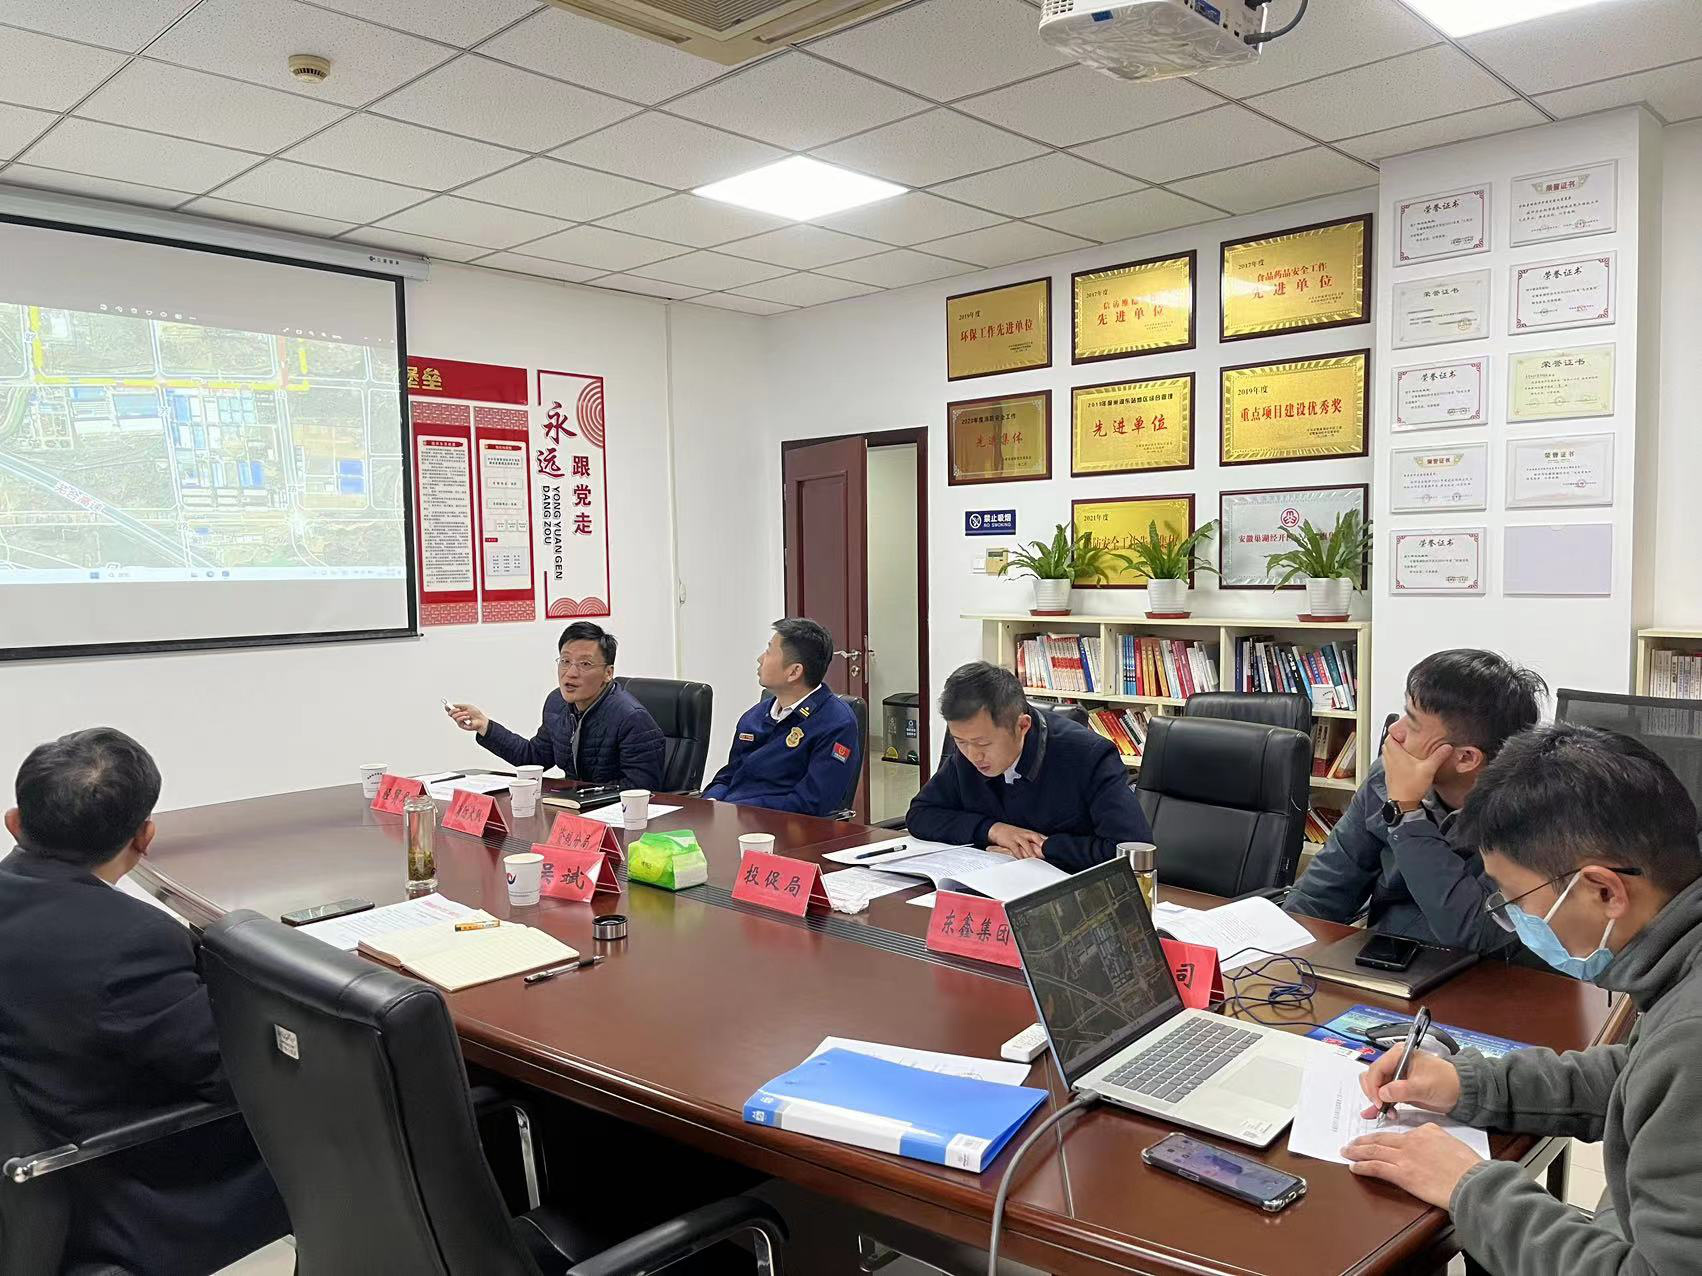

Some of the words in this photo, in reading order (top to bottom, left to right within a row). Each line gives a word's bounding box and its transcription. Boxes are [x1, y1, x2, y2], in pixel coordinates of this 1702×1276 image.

[1423, 199, 1460, 214] 荣誉证书
[1238, 259, 1264, 270] 2017年度
[1257, 262, 1327, 282] 食品药品安全工作
[1543, 266, 1583, 280] 荣誉证书
[1423, 288, 1459, 298] 荣誉证书
[1097, 304, 1164, 326] 先进单位
[960, 318, 1034, 342] 环保工作先进单位
[1540, 358, 1586, 369] 荣誉证书
[1421, 370, 1457, 382] 荣誉证书
[1237, 385, 1269, 396] 2019年度
[1241, 398, 1342, 422] 重点项目建设优秀奖
[1092, 413, 1168, 437] 先进单位
[537, 401, 578, 479] 永远
[542, 485, 552, 519] DANG
[552, 486, 562, 519] YONG
[571, 455, 593, 536] 跟党走
[983, 513, 1012, 522] 禁止吸烟
[1083, 514, 1109, 522] 2021年度
[543, 521, 552, 544] ZOU
[553, 521, 563, 554] YUAN
[1419, 538, 1455, 548] 荣誉证书
[554, 555, 564, 580] GEN
[743, 863, 801, 898] 投促局
[941, 909, 1010, 946] 东鑫集团
